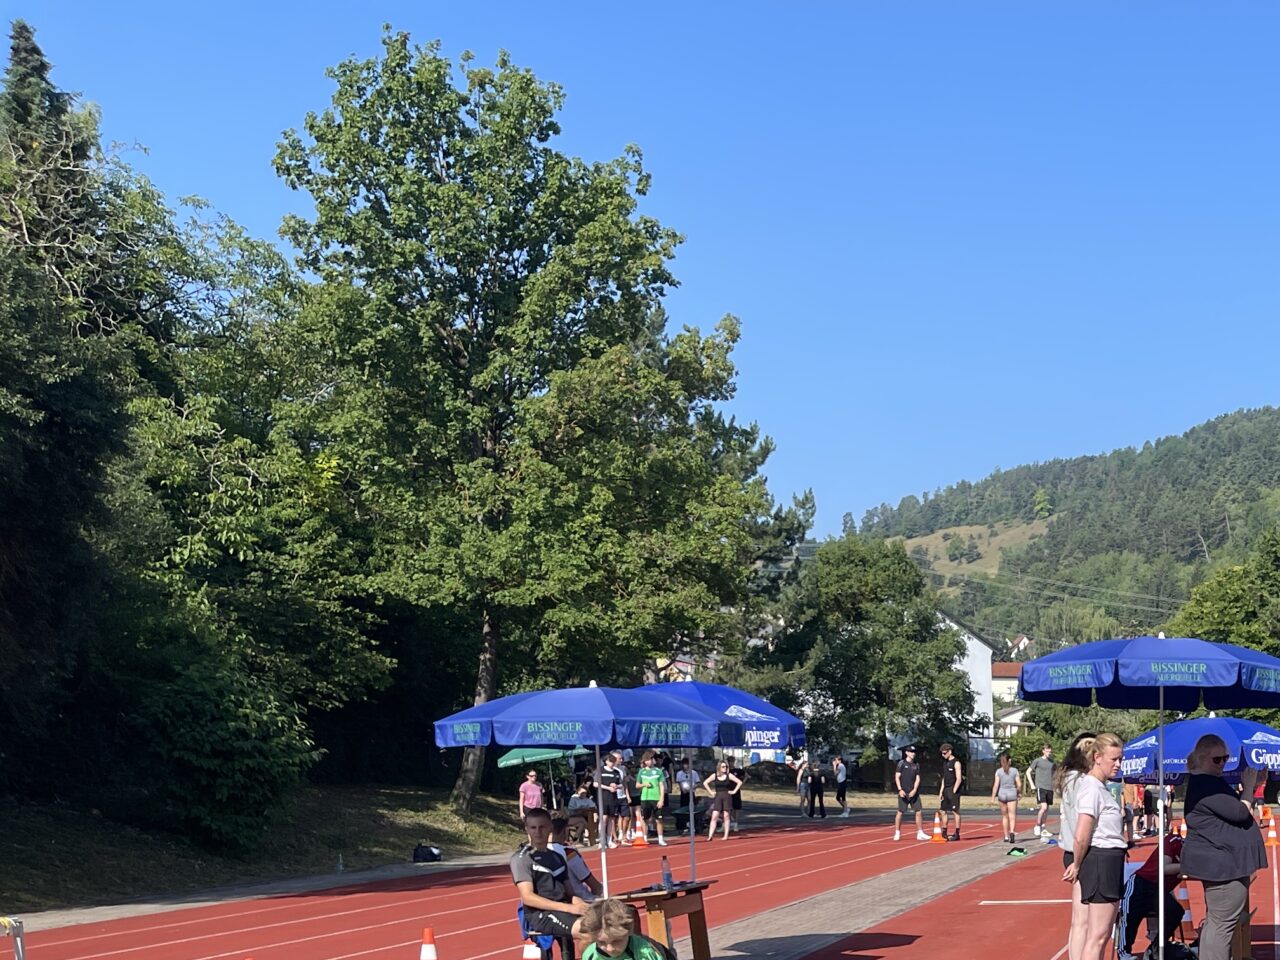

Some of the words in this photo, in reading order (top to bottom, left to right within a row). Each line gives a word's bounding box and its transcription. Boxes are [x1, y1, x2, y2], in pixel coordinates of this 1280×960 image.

[1049, 664, 1093, 677] BISSINGER
[1151, 662, 1207, 674] BISSINGER
[527, 721, 583, 732] BISSINGER
[1120, 753, 1149, 776] öppinger
